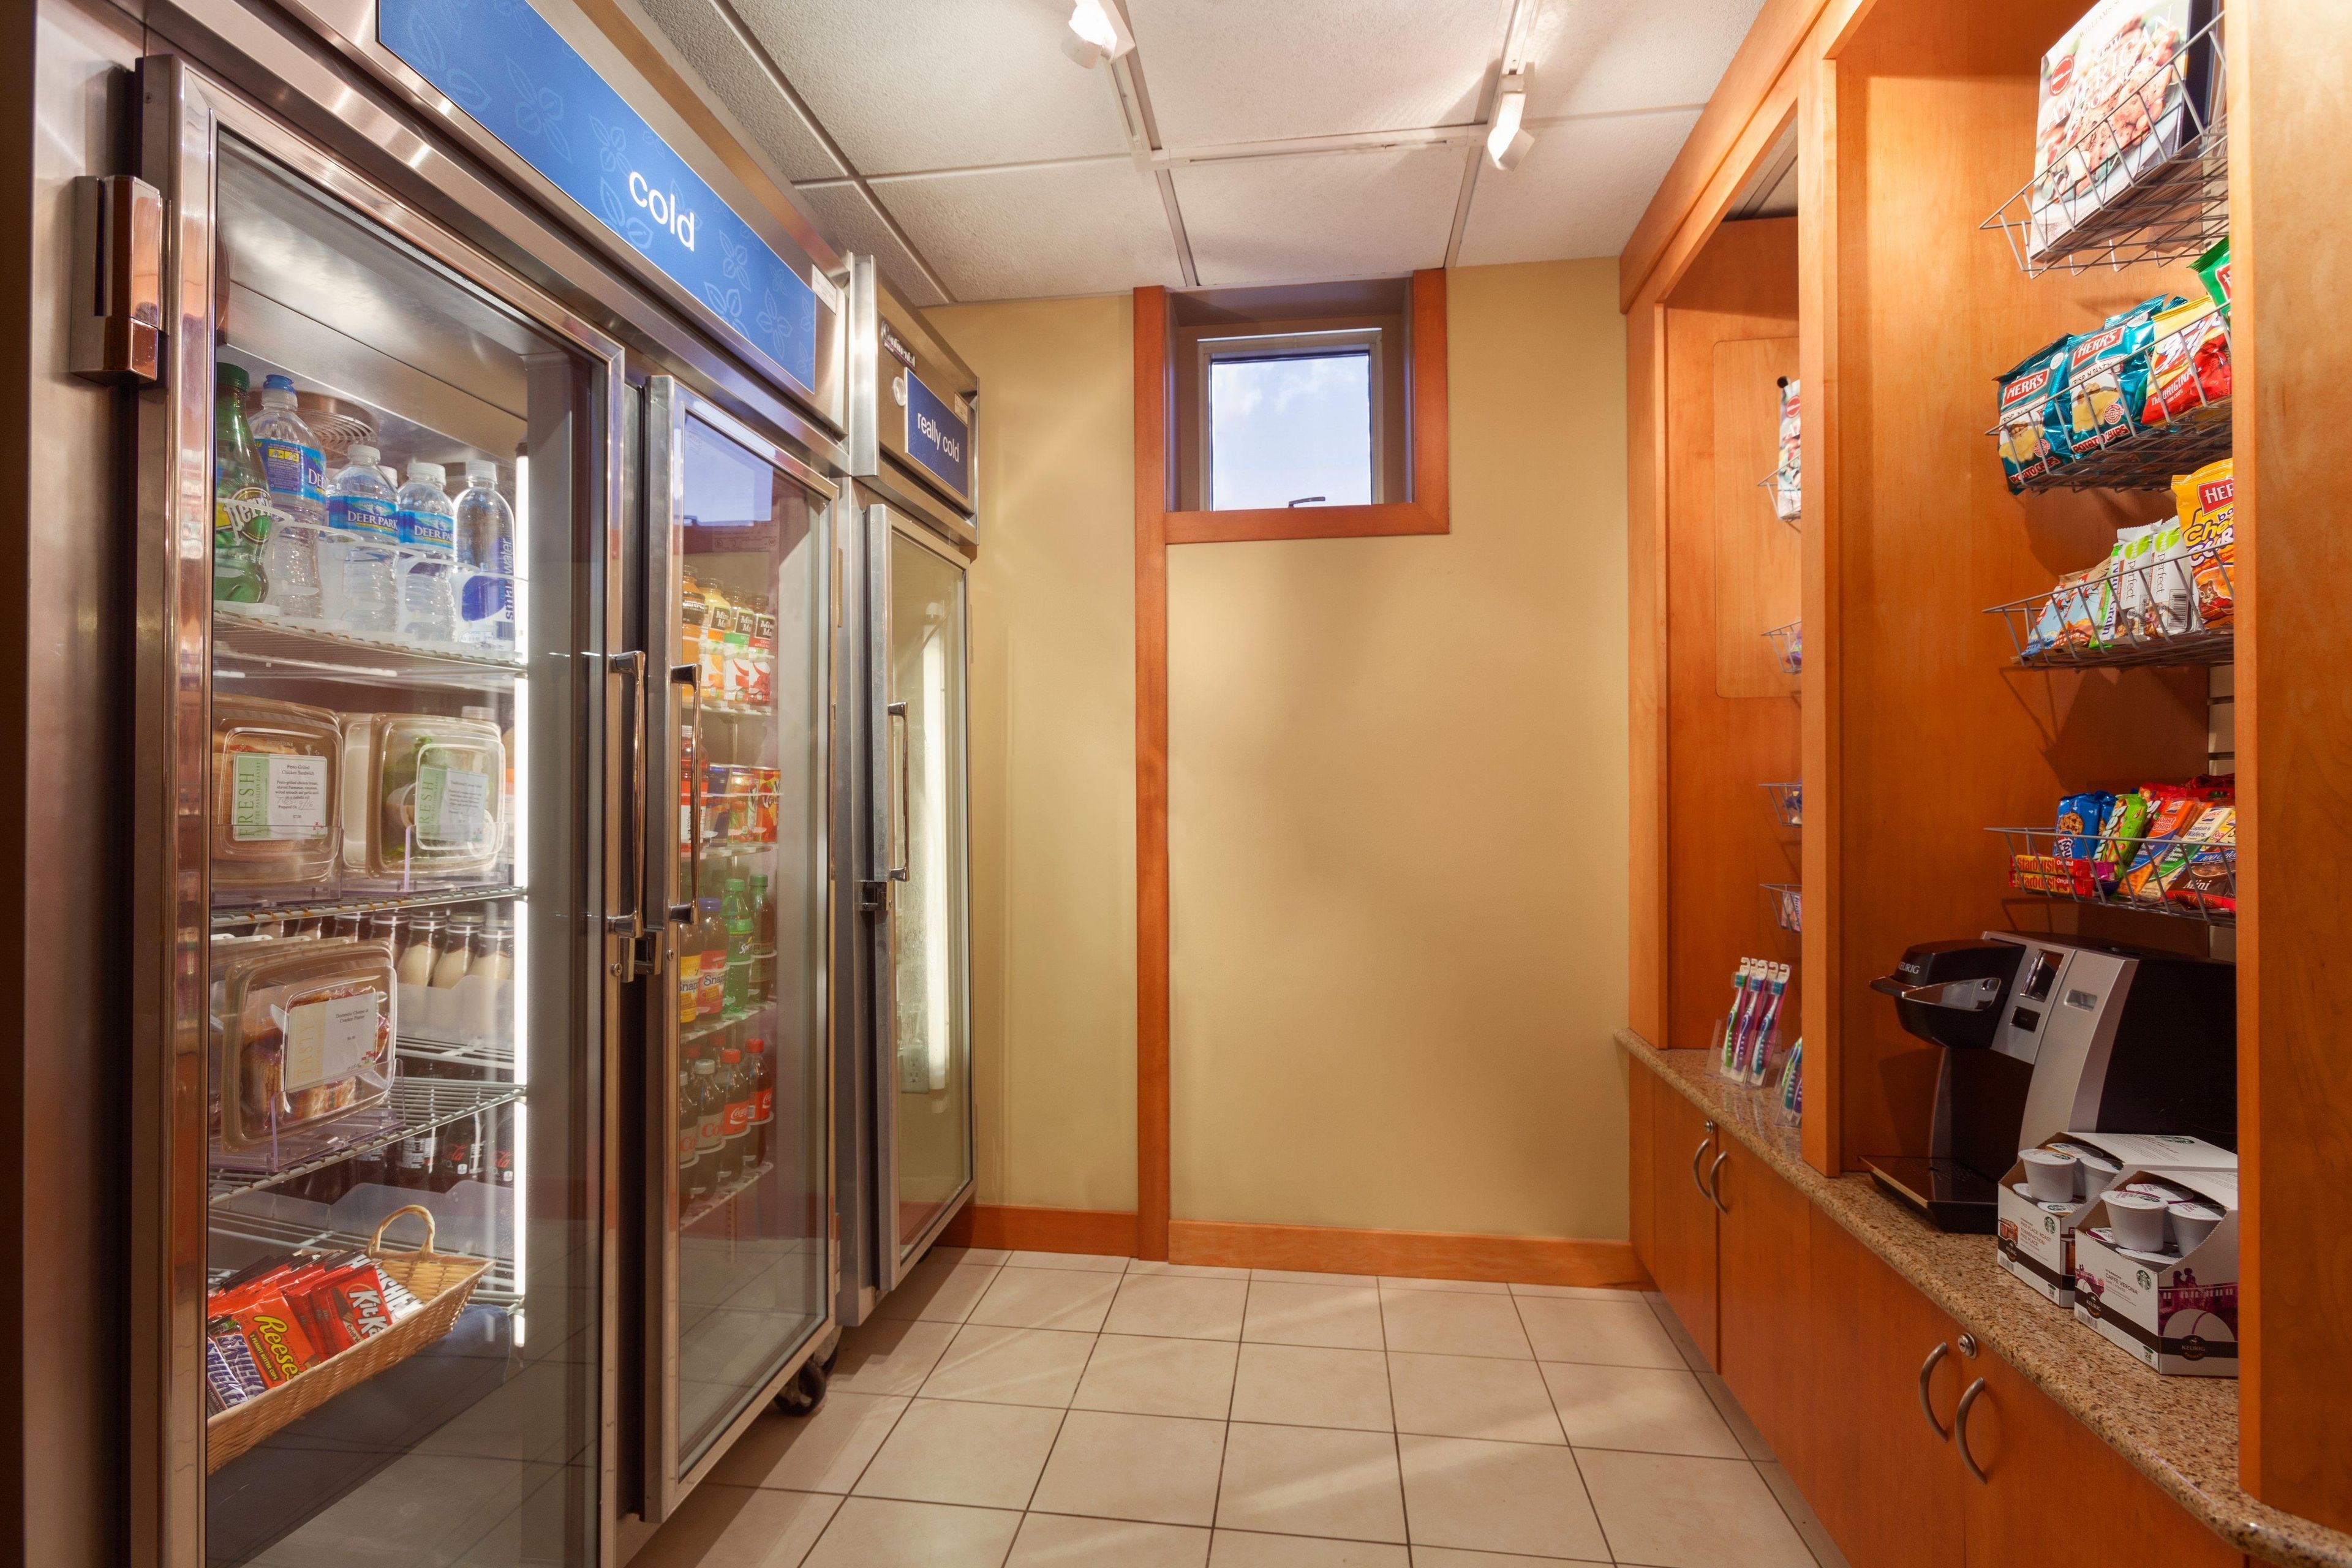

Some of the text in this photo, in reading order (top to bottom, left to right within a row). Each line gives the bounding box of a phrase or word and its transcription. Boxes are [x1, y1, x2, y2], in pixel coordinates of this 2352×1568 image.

[629, 171, 695, 252] cold
[2078, 330, 2118, 359] HERR'S
[2006, 374, 2045, 399] HERR'S
[918, 413, 960, 463] really cold
[347, 511, 398, 530] DEER PARK
[414, 525, 440, 539] DEER
[238, 773, 255, 837] FRESH
[298, 1024, 314, 1075] TASTY
[251, 1337, 263, 1354] PEANUT
[260, 1353, 272, 1371] BUTTER
